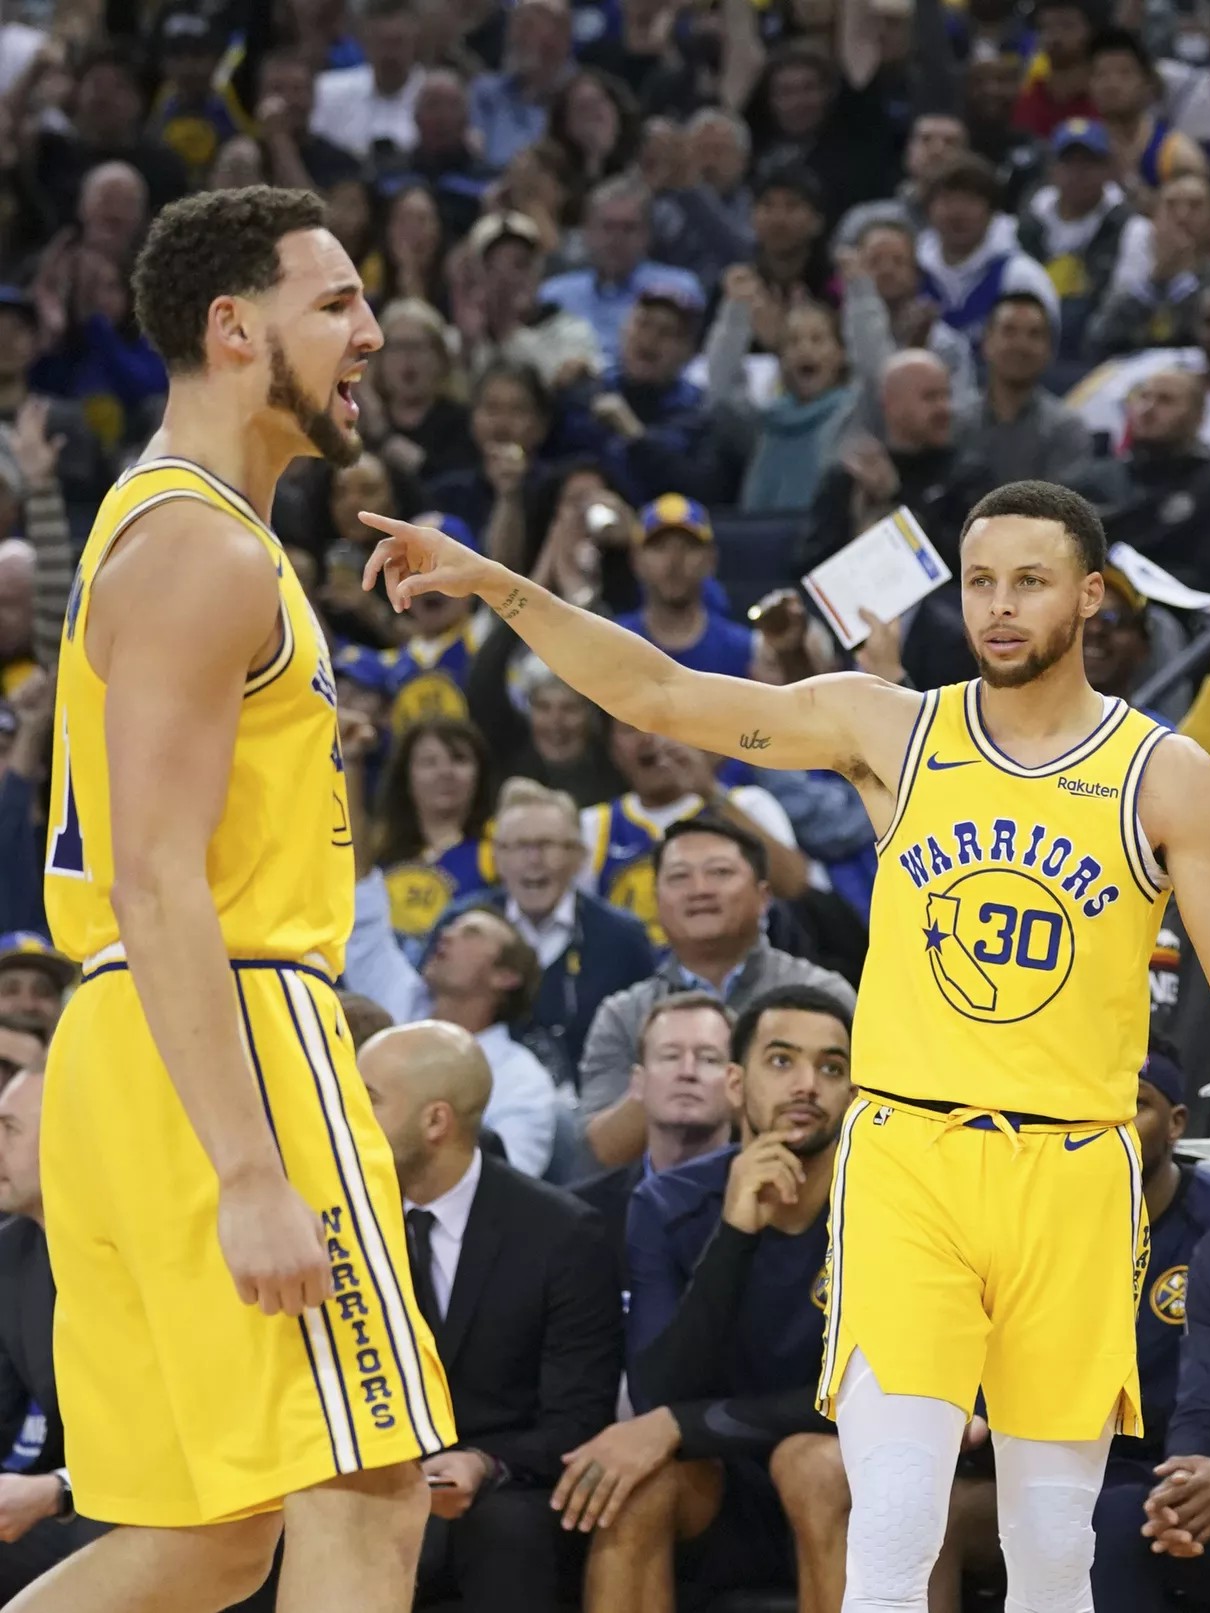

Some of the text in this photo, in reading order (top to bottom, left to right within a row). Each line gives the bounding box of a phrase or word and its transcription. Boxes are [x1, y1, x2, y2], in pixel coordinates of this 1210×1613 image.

[1057, 776, 1119, 798] Rakuten
[899, 818, 1120, 918] WARRIORS
[973, 902, 1064, 971] 30
